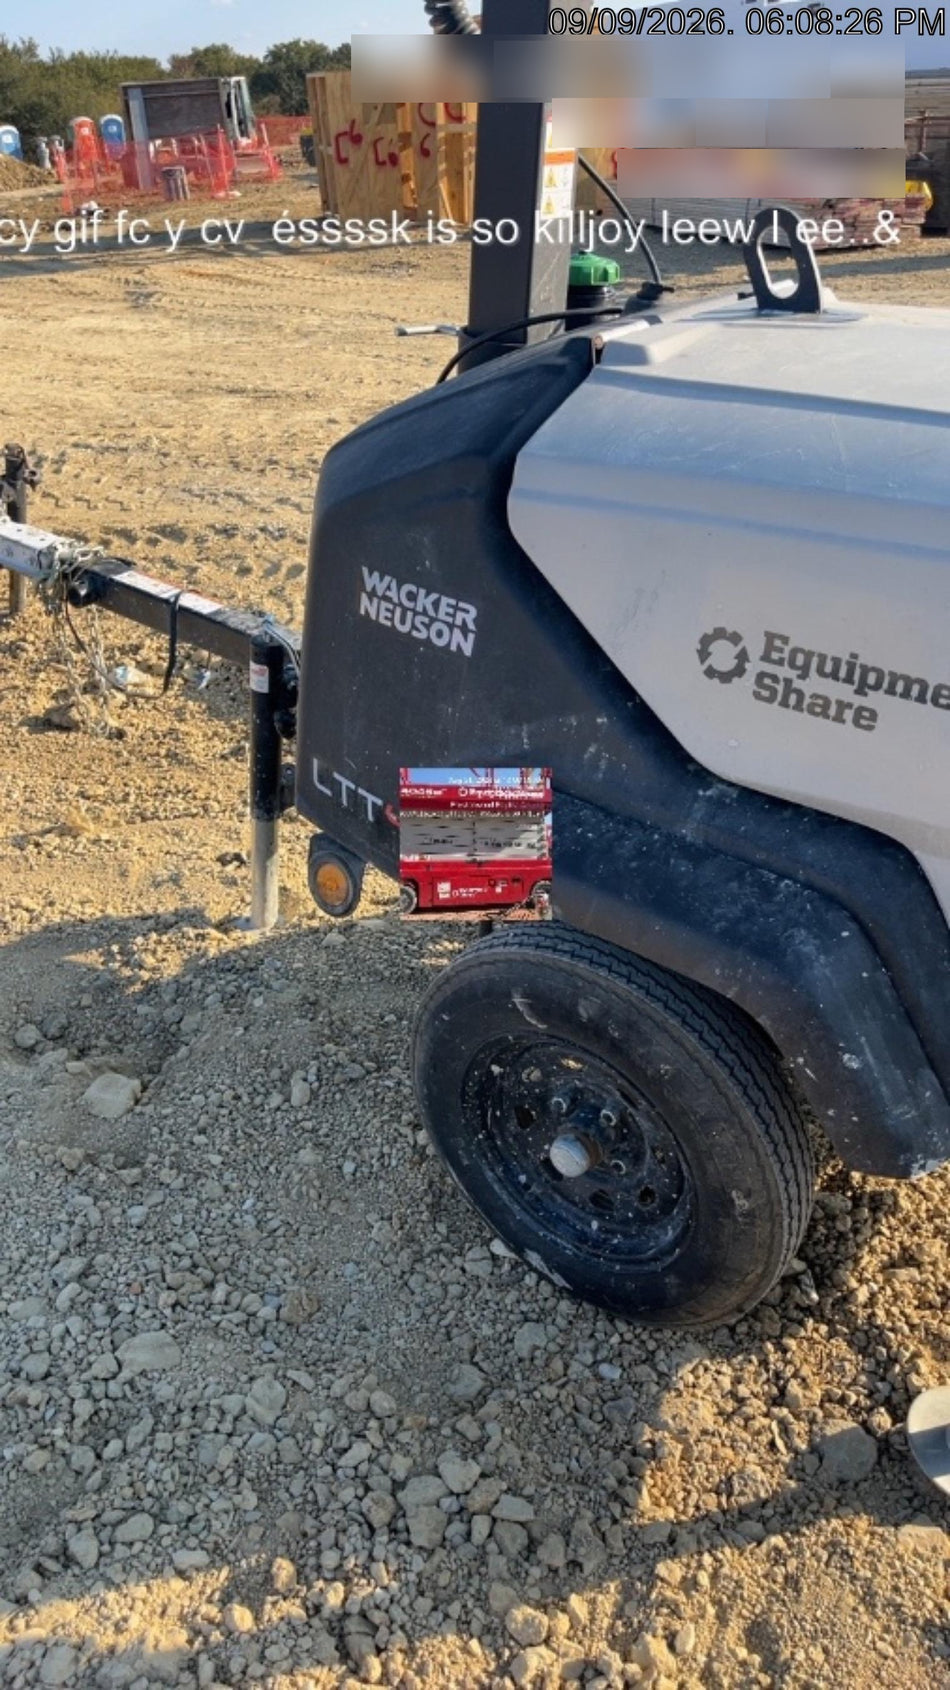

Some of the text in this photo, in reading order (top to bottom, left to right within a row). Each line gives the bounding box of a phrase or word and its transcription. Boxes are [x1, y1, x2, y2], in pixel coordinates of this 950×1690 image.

[359, 592, 476, 658] NEUSON
[361, 565, 478, 632] WACKER
[752, 670, 878, 731] Share
